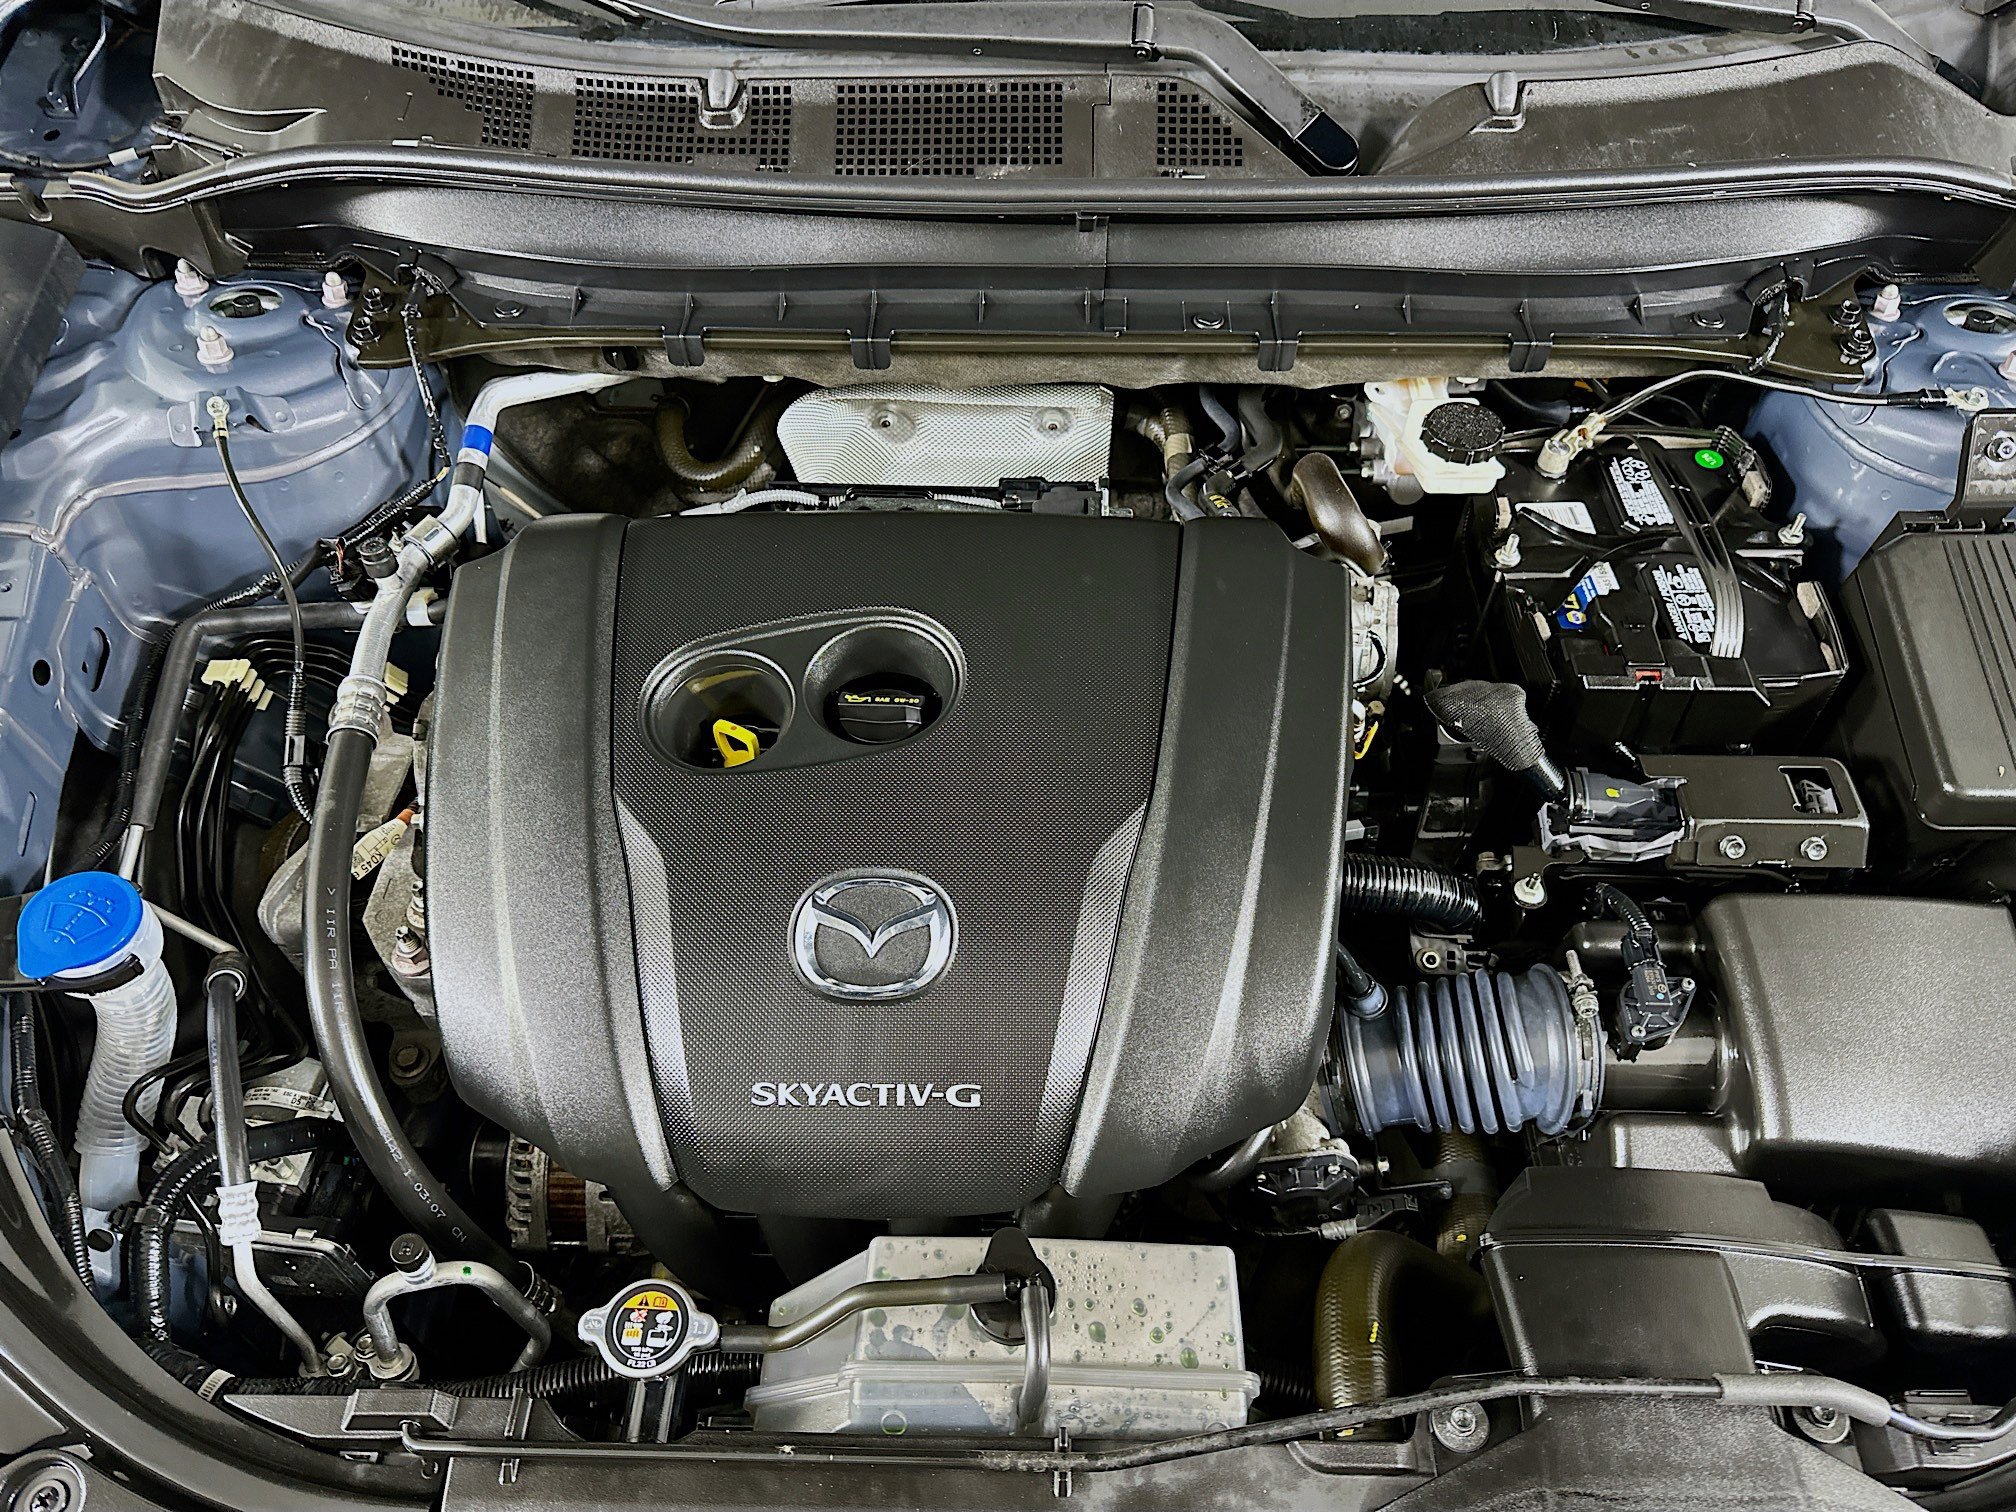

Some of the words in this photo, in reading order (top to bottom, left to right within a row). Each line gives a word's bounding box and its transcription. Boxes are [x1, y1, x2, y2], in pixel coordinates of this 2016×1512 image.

[360, 850, 384, 873] KD45
[750, 1081, 982, 1108] SKYACTIV-G
[414, 1182, 447, 1218] 03:07
